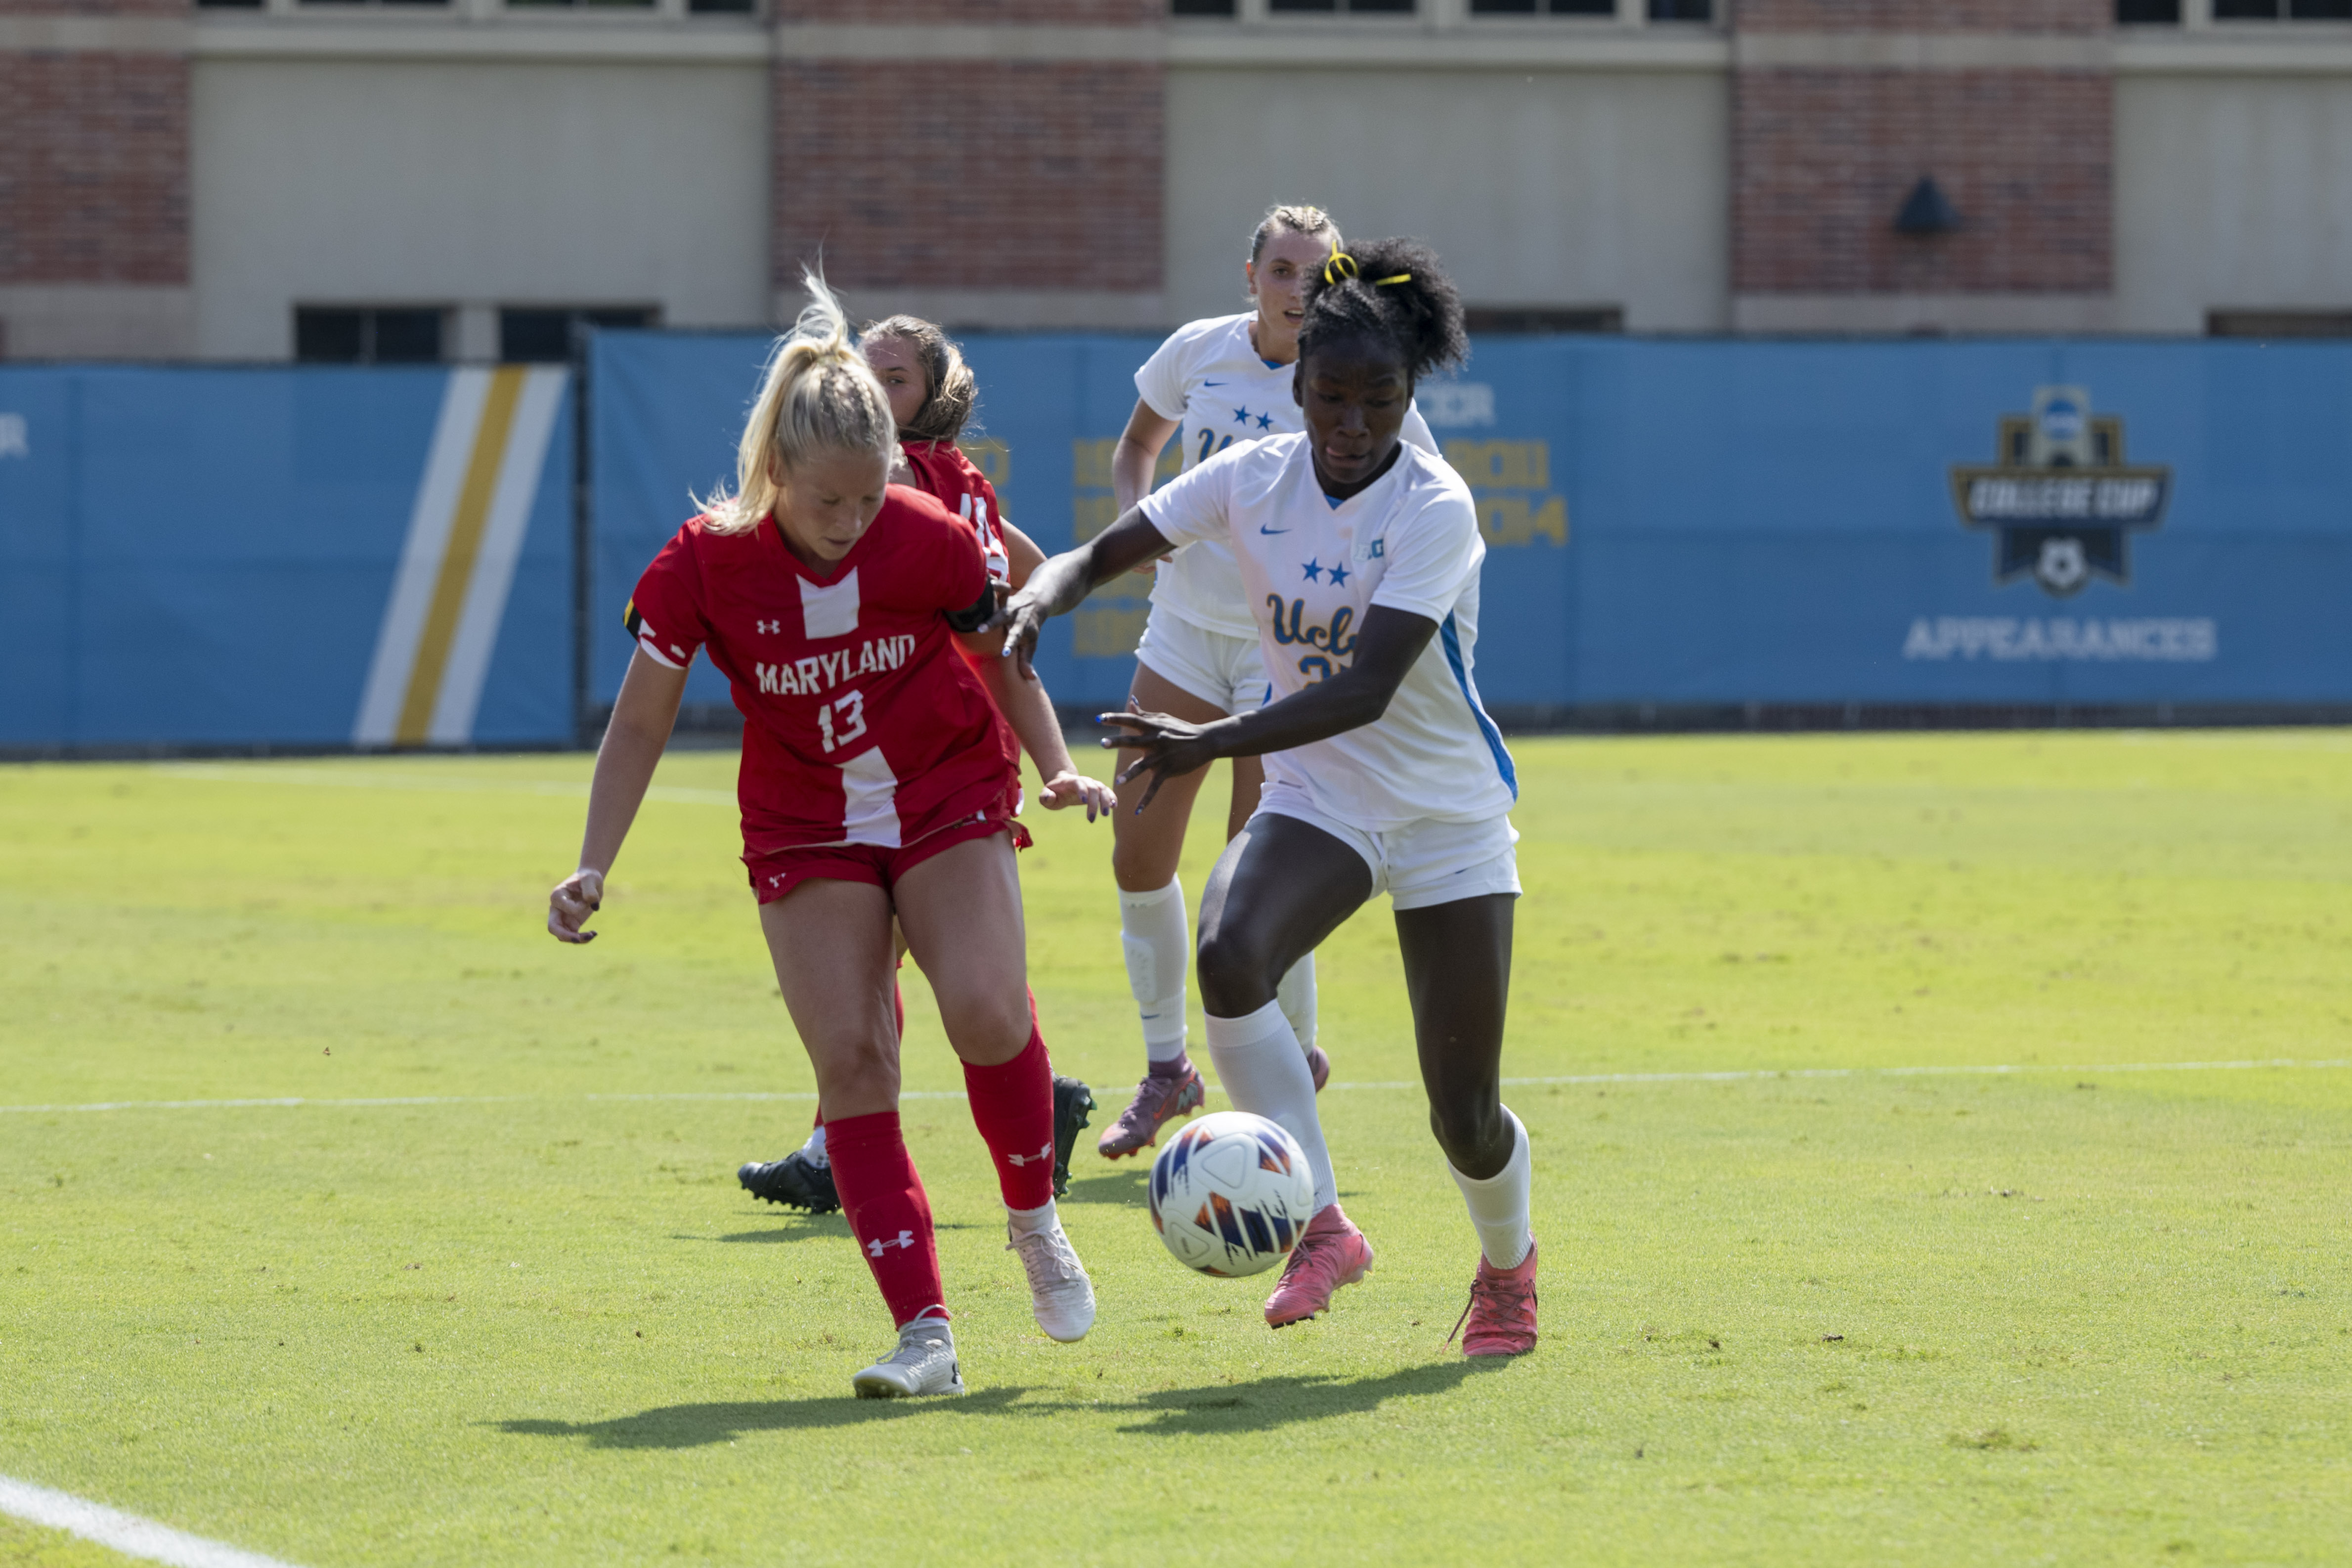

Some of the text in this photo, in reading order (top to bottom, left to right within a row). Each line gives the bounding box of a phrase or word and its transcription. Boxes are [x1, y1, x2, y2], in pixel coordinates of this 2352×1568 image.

[2094, 478, 2159, 519] CUP
[755, 635, 915, 695] MARYLAND
[1903, 618, 2218, 661] APPEARANCES
[818, 690, 868, 754] 13
